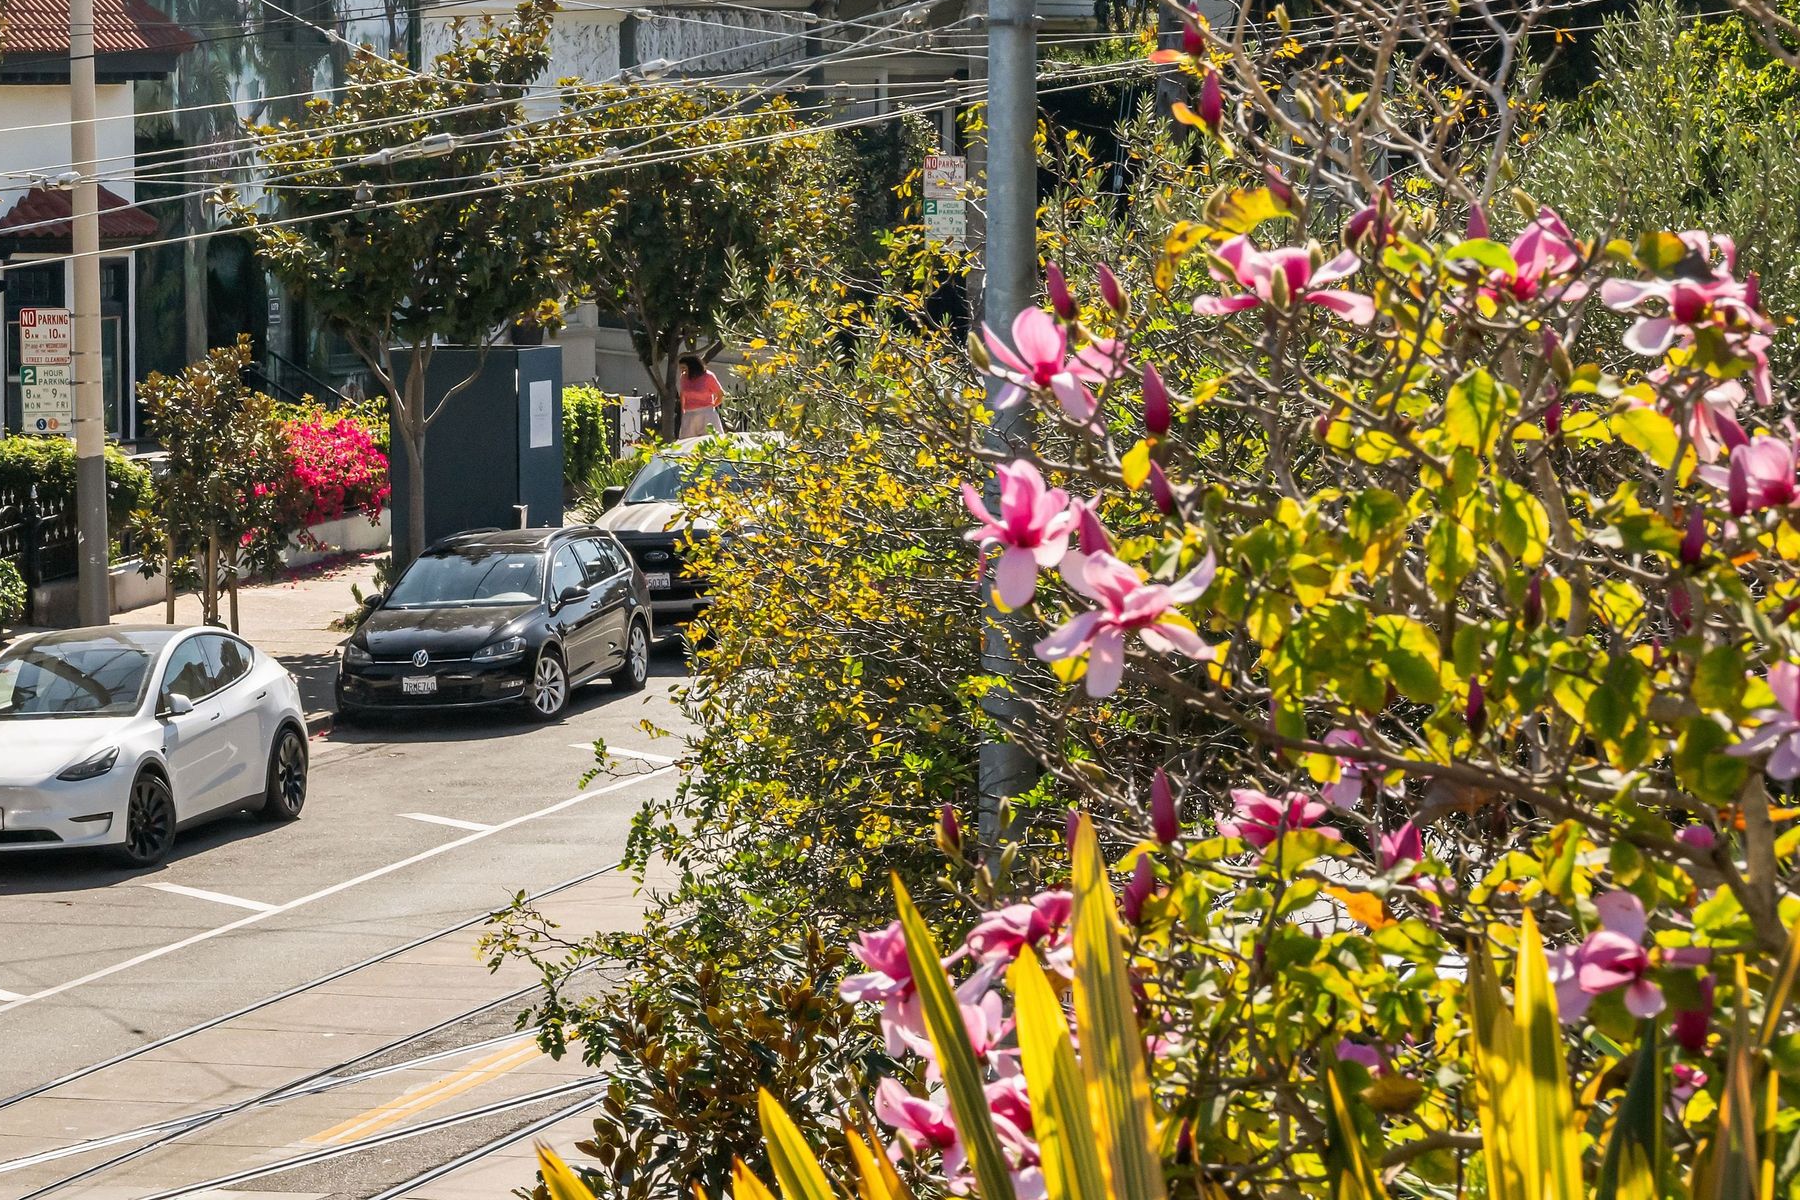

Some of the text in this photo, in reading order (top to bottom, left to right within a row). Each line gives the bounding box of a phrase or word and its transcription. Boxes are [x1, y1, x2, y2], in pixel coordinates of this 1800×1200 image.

[926, 157, 936, 168] NO
[926, 202, 935, 212] 2
[22, 311, 68, 325] NO PARKING
[23, 369, 34, 382] 2
